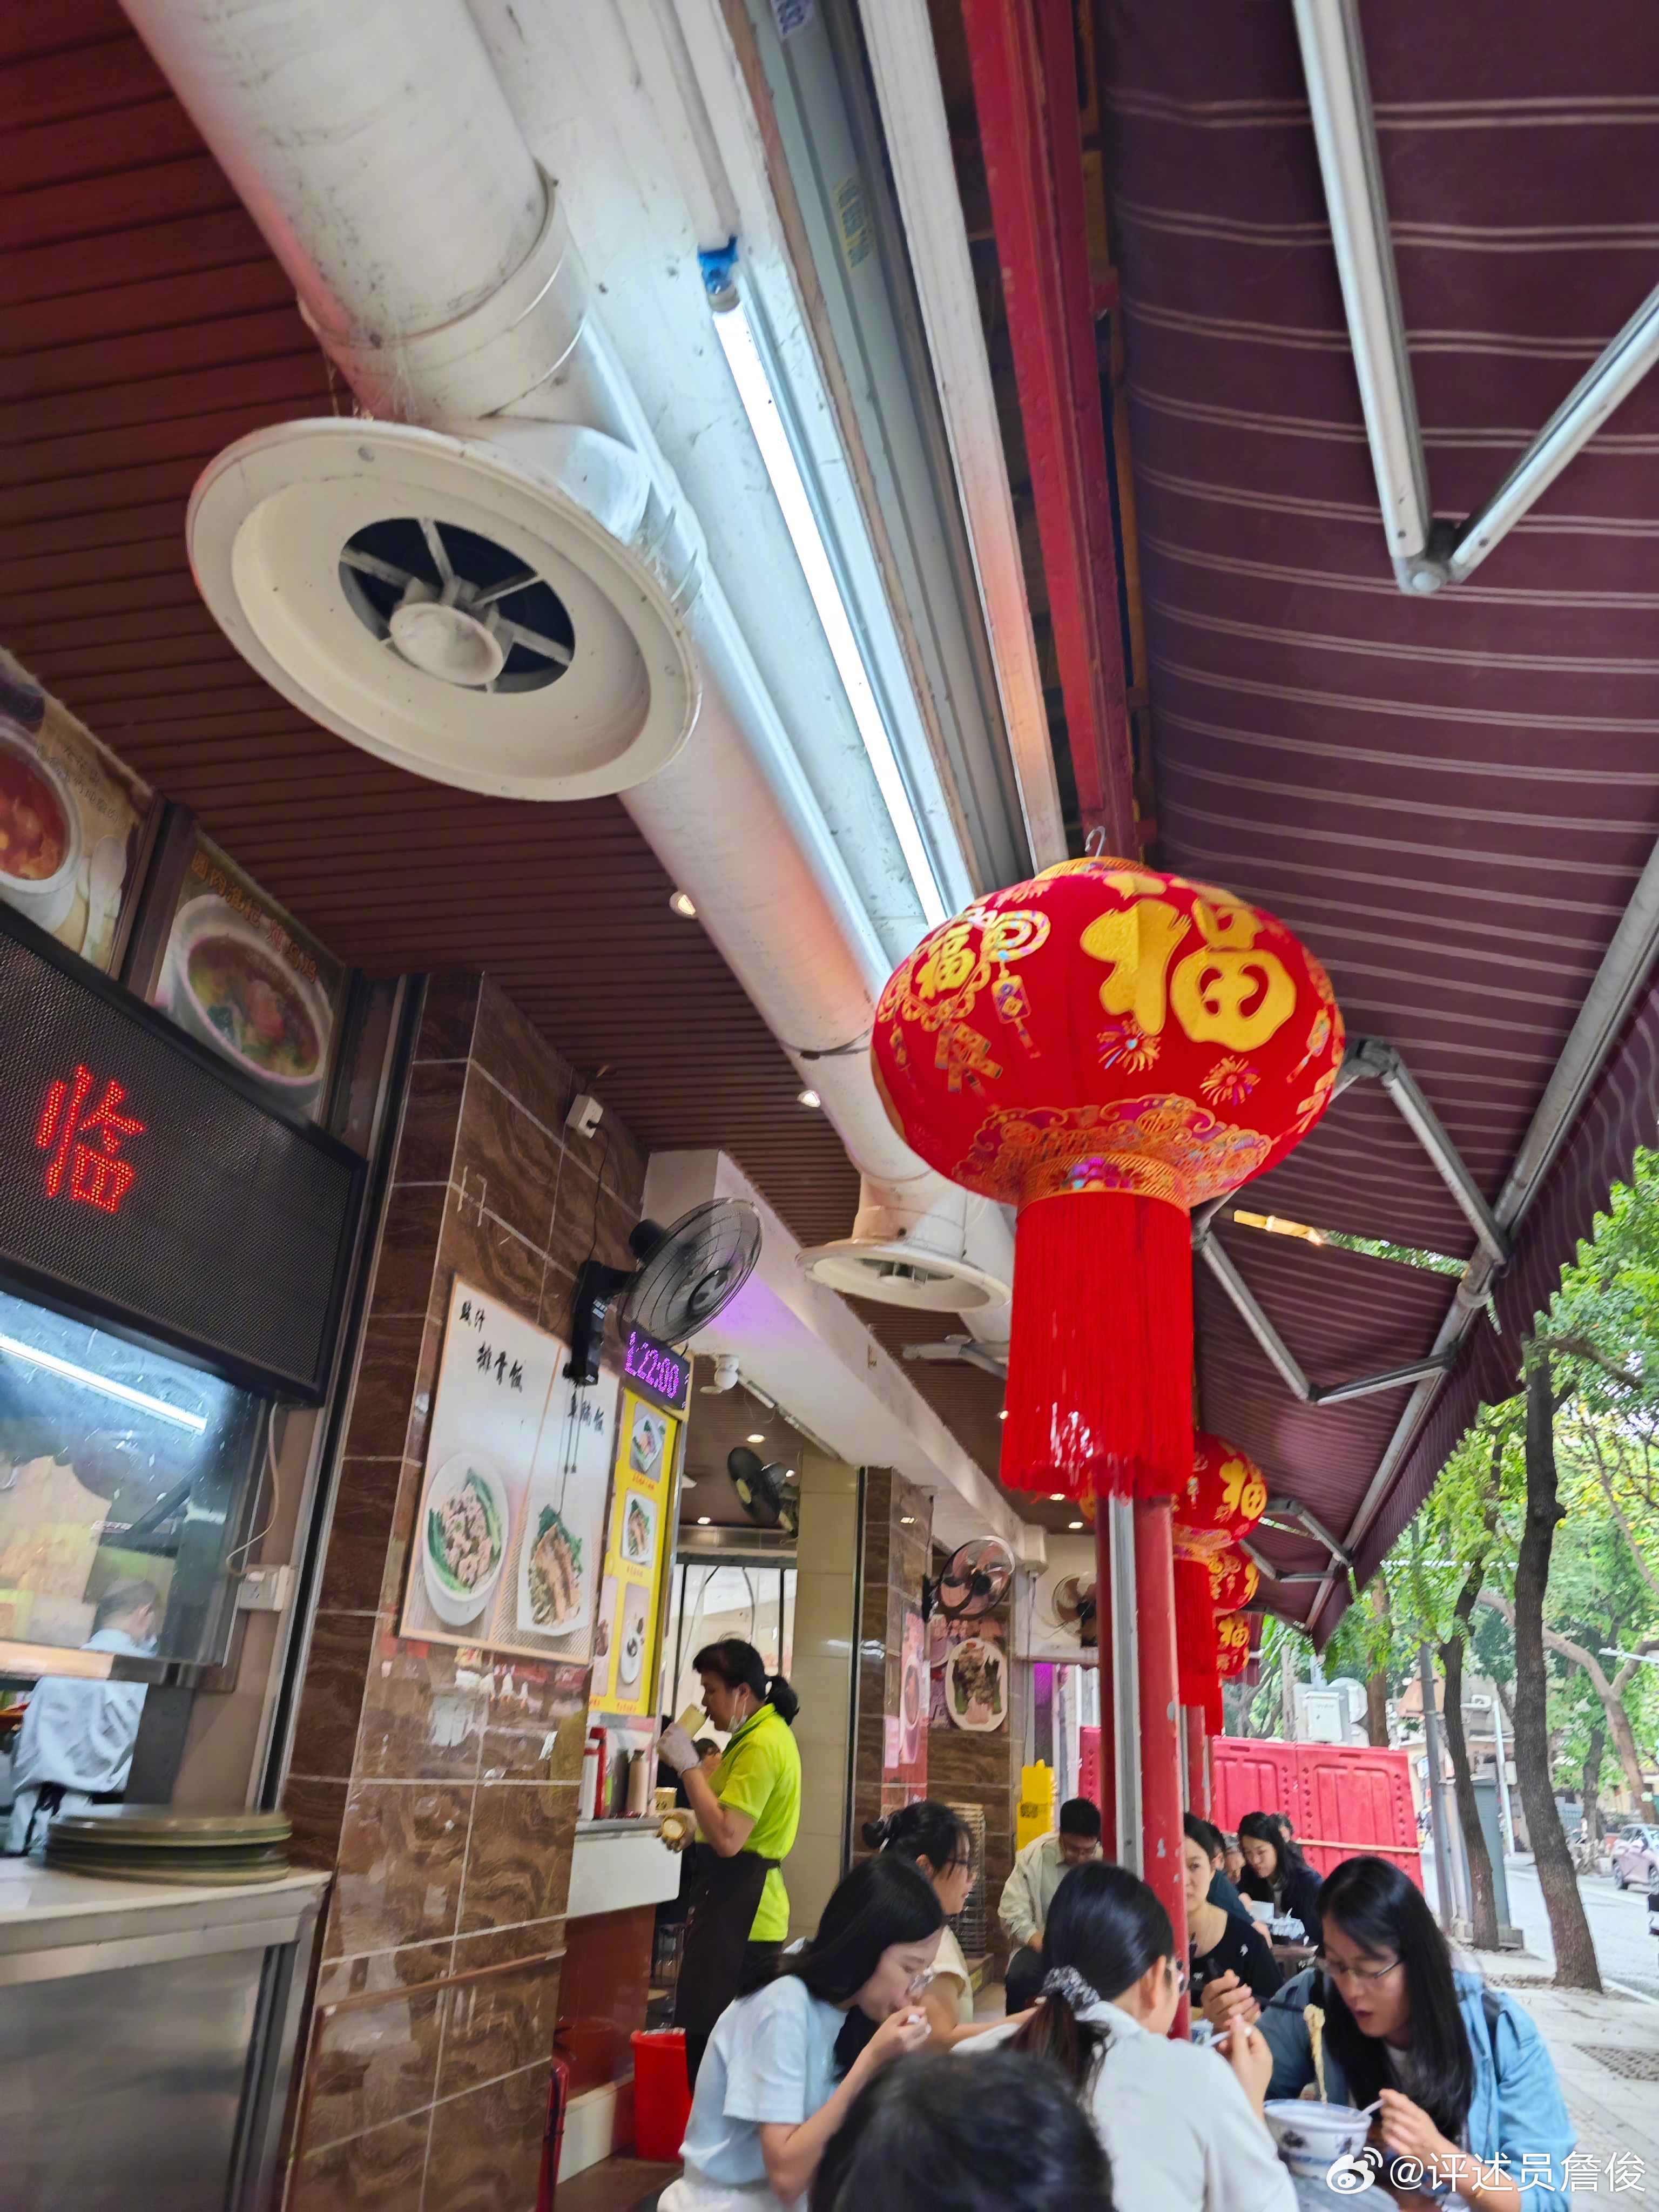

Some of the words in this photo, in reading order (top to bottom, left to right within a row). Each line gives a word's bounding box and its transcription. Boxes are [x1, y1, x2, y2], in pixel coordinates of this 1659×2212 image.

[915, 923, 976, 999] 福
[1080, 872, 1297, 1053] 福
[37, 1065, 145, 1212] 临
